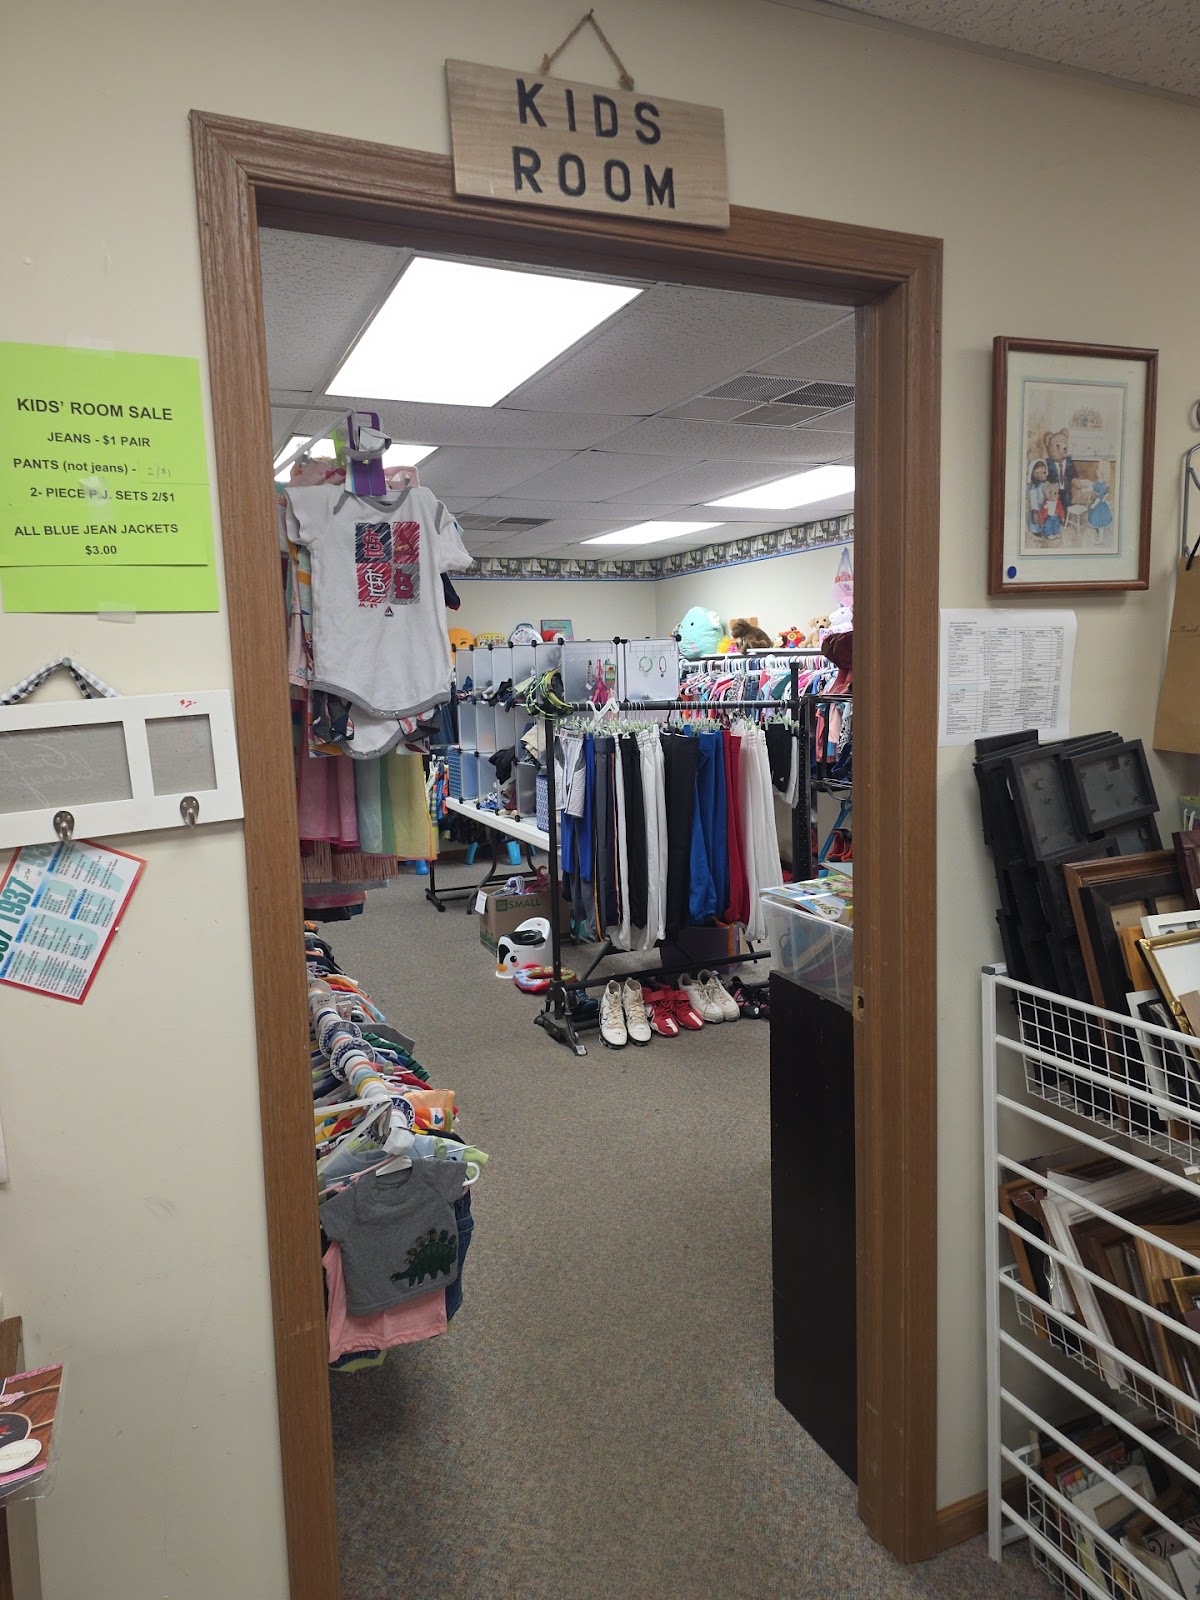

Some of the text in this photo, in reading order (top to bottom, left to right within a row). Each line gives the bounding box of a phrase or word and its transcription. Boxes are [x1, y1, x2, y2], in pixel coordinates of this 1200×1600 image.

[516, 78, 661, 145] KIDS
[512, 145, 675, 209] ROOM
[17, 397, 173, 421] KIDS’ ROOM SALE
[47, 432, 91, 444] JEANS
[102, 434, 116, 446] $1
[120, 436, 151, 448] PAIR
[13, 458, 59, 470] PANTS
[63, 461, 88, 473] (not
[91, 462, 128, 475] jeans)
[30, 487, 175, 502] 2- PIECE P.J. SETS 2/$1
[14, 523, 179, 536] ALL BLUE JEAN JACKETS
[85, 545, 117, 556] $3.00
[0, 876, 35, 925] 1937
[508, 898, 541, 910] SMALL
